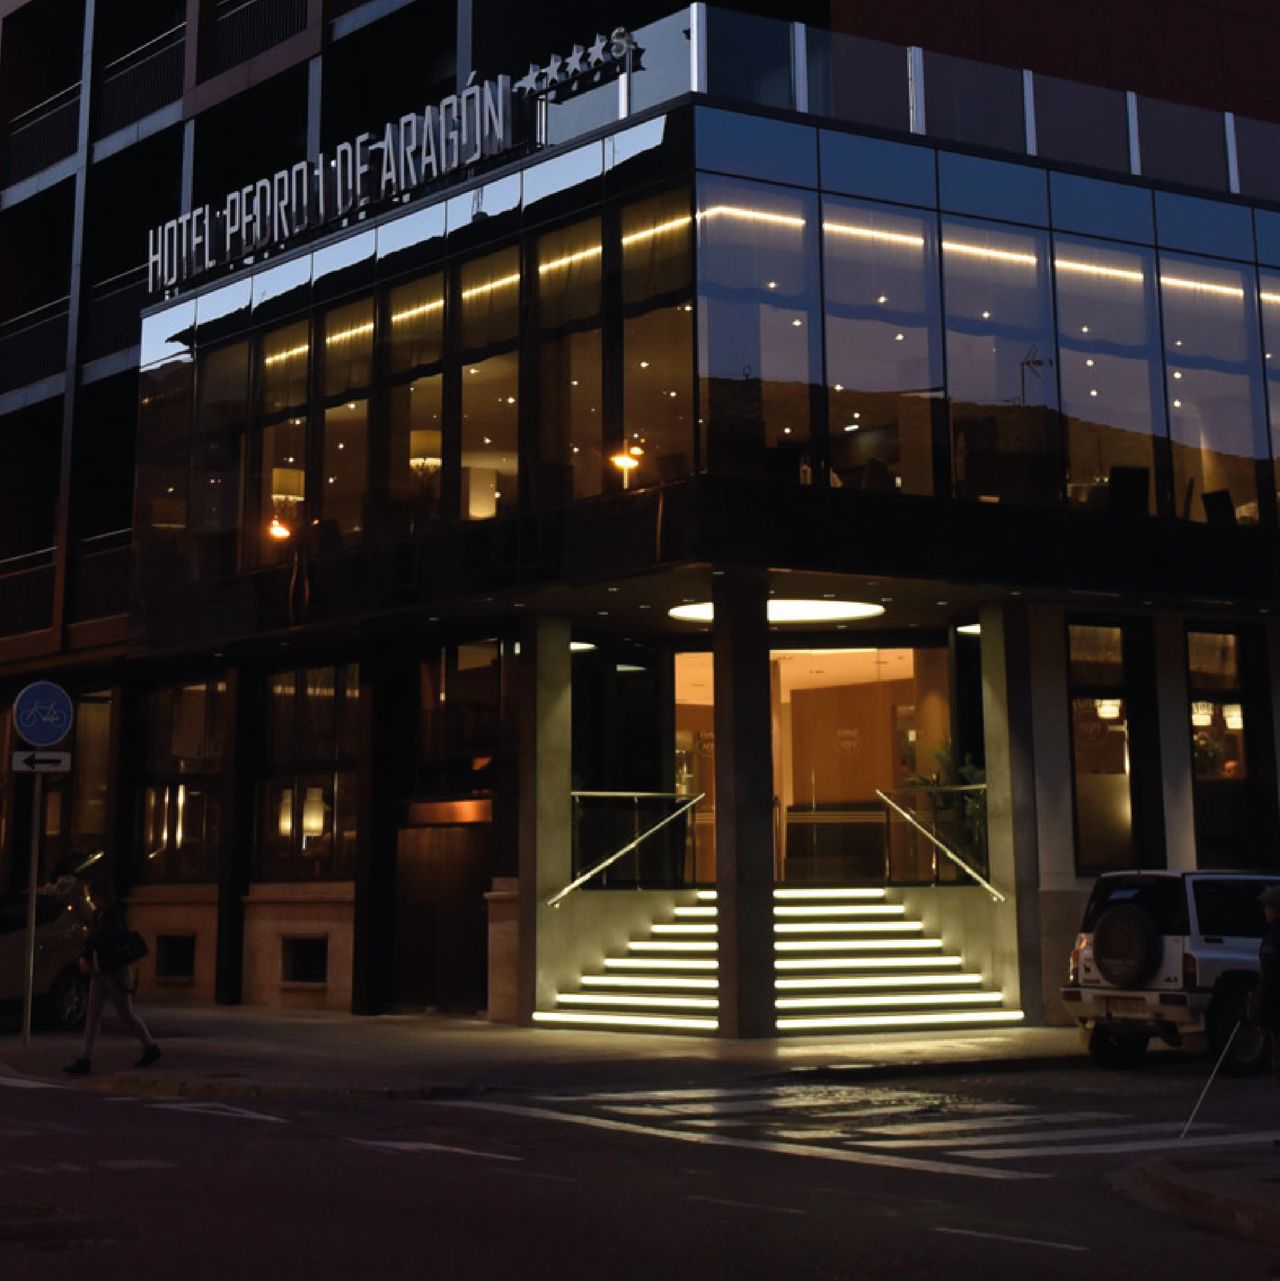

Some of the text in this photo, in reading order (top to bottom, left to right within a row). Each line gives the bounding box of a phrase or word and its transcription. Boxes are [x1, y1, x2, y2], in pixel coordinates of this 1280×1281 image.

[147, 203, 217, 294] HOTEL
[224, 159, 309, 262] PEDRO
[335, 132, 371, 216] DE
[380, 70, 506, 201] ARAGÓN
